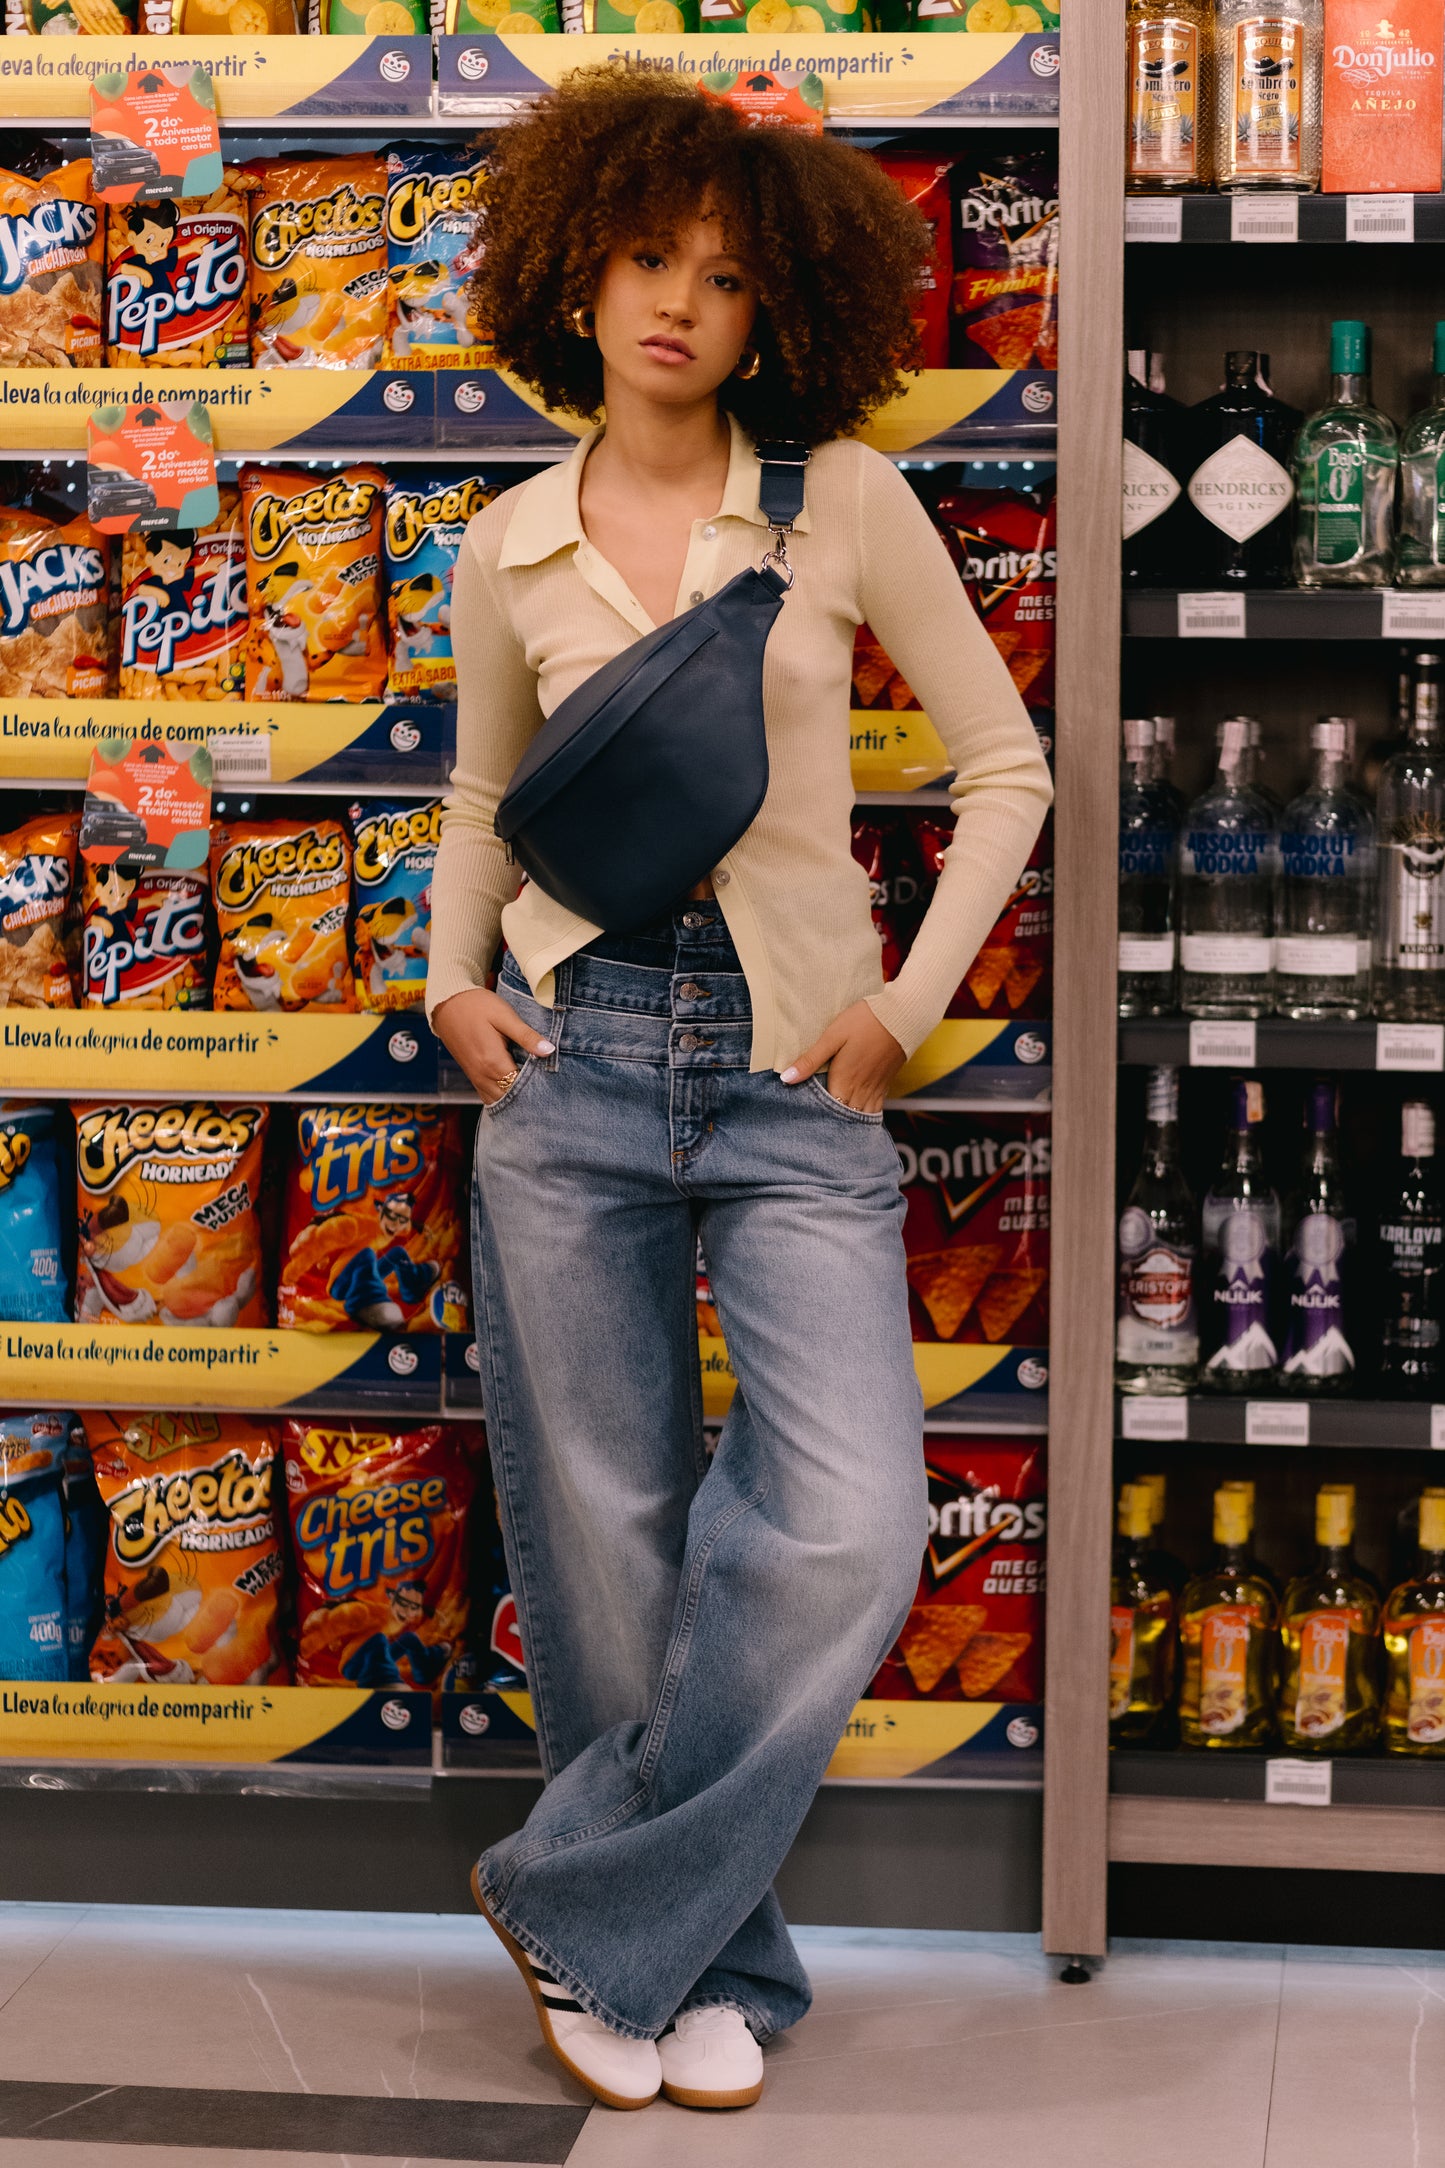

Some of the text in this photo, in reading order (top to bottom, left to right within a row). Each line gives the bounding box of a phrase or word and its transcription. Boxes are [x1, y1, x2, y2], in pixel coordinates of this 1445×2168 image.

[36, 53, 53, 76] la
[126, 52, 147, 72] de
[678, 50, 696, 73] la
[769, 50, 791, 73] de
[796, 51, 894, 80] compartir
[1332, 45, 1384, 69] Don
[1350, 98, 1417, 111] AÑEJO
[143, 117, 160, 139] 2
[161, 125, 212, 137] Aniversario
[145, 133, 211, 147] a todo motor
[181, 142, 212, 152] cero km
[145, 185, 174, 195] mercato
[181, 224, 233, 237] el Original
[254, 185, 386, 269] Cheetos
[107, 234, 246, 357] Pepito
[424, 351, 459, 368] SABOR
[463, 350, 470, 366] A
[0, 380, 40, 404] leva
[44, 382, 61, 404] la
[132, 382, 154, 404] de
[140, 450, 157, 471] 2
[159, 458, 209, 470] Aniversario
[151, 469, 174, 480] todo
[177, 467, 208, 478] motor
[1193, 482, 1287, 497] HENDRICK'S
[1226, 502, 1255, 511] GIN
[140, 517, 169, 527] mercato
[251, 478, 379, 561] Cheetos
[122, 557, 249, 677] Pepito
[3, 715, 50, 738] Lleva
[54, 716, 70, 739] la
[141, 717, 163, 740] de
[138, 786, 153, 807] 2
[146, 806, 169, 817] todo
[171, 808, 203, 818] motor
[1187, 832, 1267, 854] ABSOLUT
[217, 831, 346, 910] Cheetos
[1194, 853, 1258, 875] VODKA
[84, 895, 204, 1005] Pepito
[4, 1025, 50, 1048] Lleva
[55, 1026, 71, 1048] la
[141, 1029, 162, 1051] de
[166, 1031, 259, 1058] compartir
[79, 1105, 256, 1186] Cheetos
[316, 1127, 419, 1204] tris
[194, 1181, 249, 1226] MEGA
[32, 1258, 58, 1279] 400g
[8, 1337, 53, 1360] Lleva
[57, 1339, 73, 1360] la
[143, 1340, 164, 1362] de
[168, 1343, 260, 1370] compartir
[299, 1478, 444, 1545] Cheese
[329, 1517, 429, 1590] tris
[29, 1622, 62, 1643] 400g
[3, 1692, 49, 1716] Lleva
[52, 1694, 69, 1716] la
[138, 1696, 159, 1718] de
[163, 1700, 254, 1725] compartir
